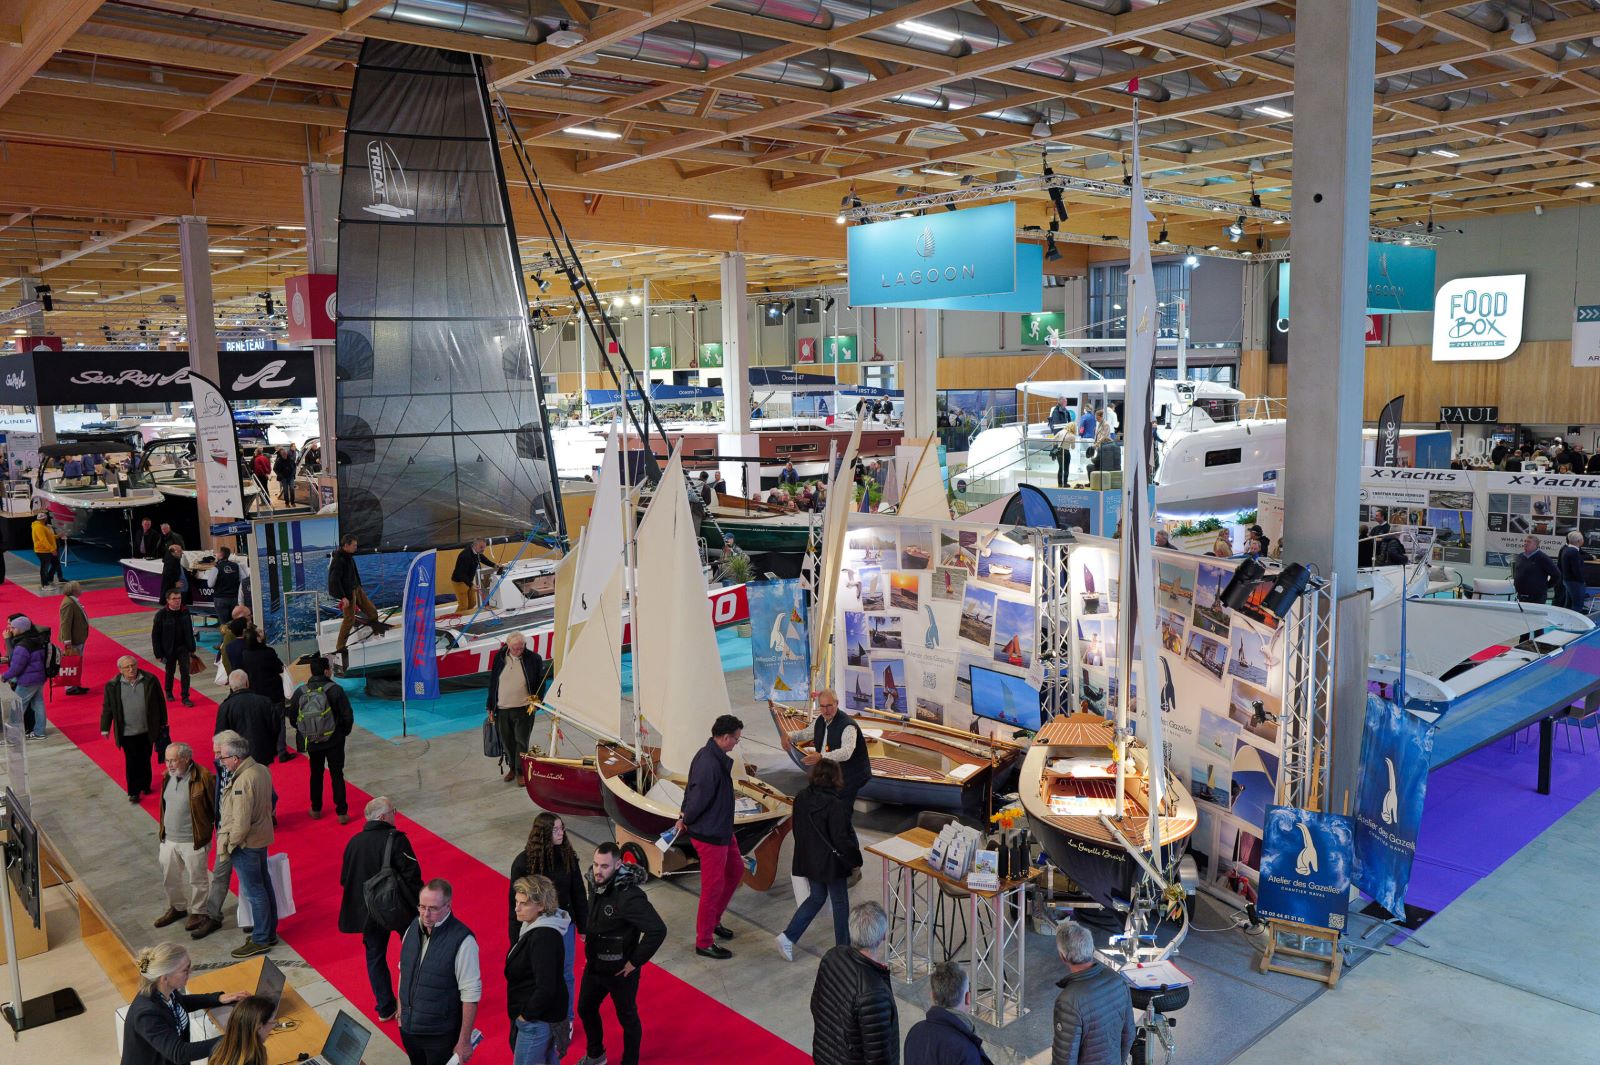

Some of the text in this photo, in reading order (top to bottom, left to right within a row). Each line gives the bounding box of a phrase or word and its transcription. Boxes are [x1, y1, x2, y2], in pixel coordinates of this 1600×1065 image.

[370, 146, 385, 198] TRICAT
[881, 263, 975, 288] LAGOON
[1367, 283, 1405, 296] AGOON
[1450, 289, 1508, 319] FOOD
[1449, 316, 1508, 339] BOX
[226, 338, 265, 351] BENETEAU
[1441, 407, 1498, 422] PAUL
[1370, 469, 1457, 481] X-Yachts
[59, 667, 77, 677] HH
[1268, 875, 1341, 895] Atelier des Gazelles
[1280, 886, 1307, 894] CHANTIER
